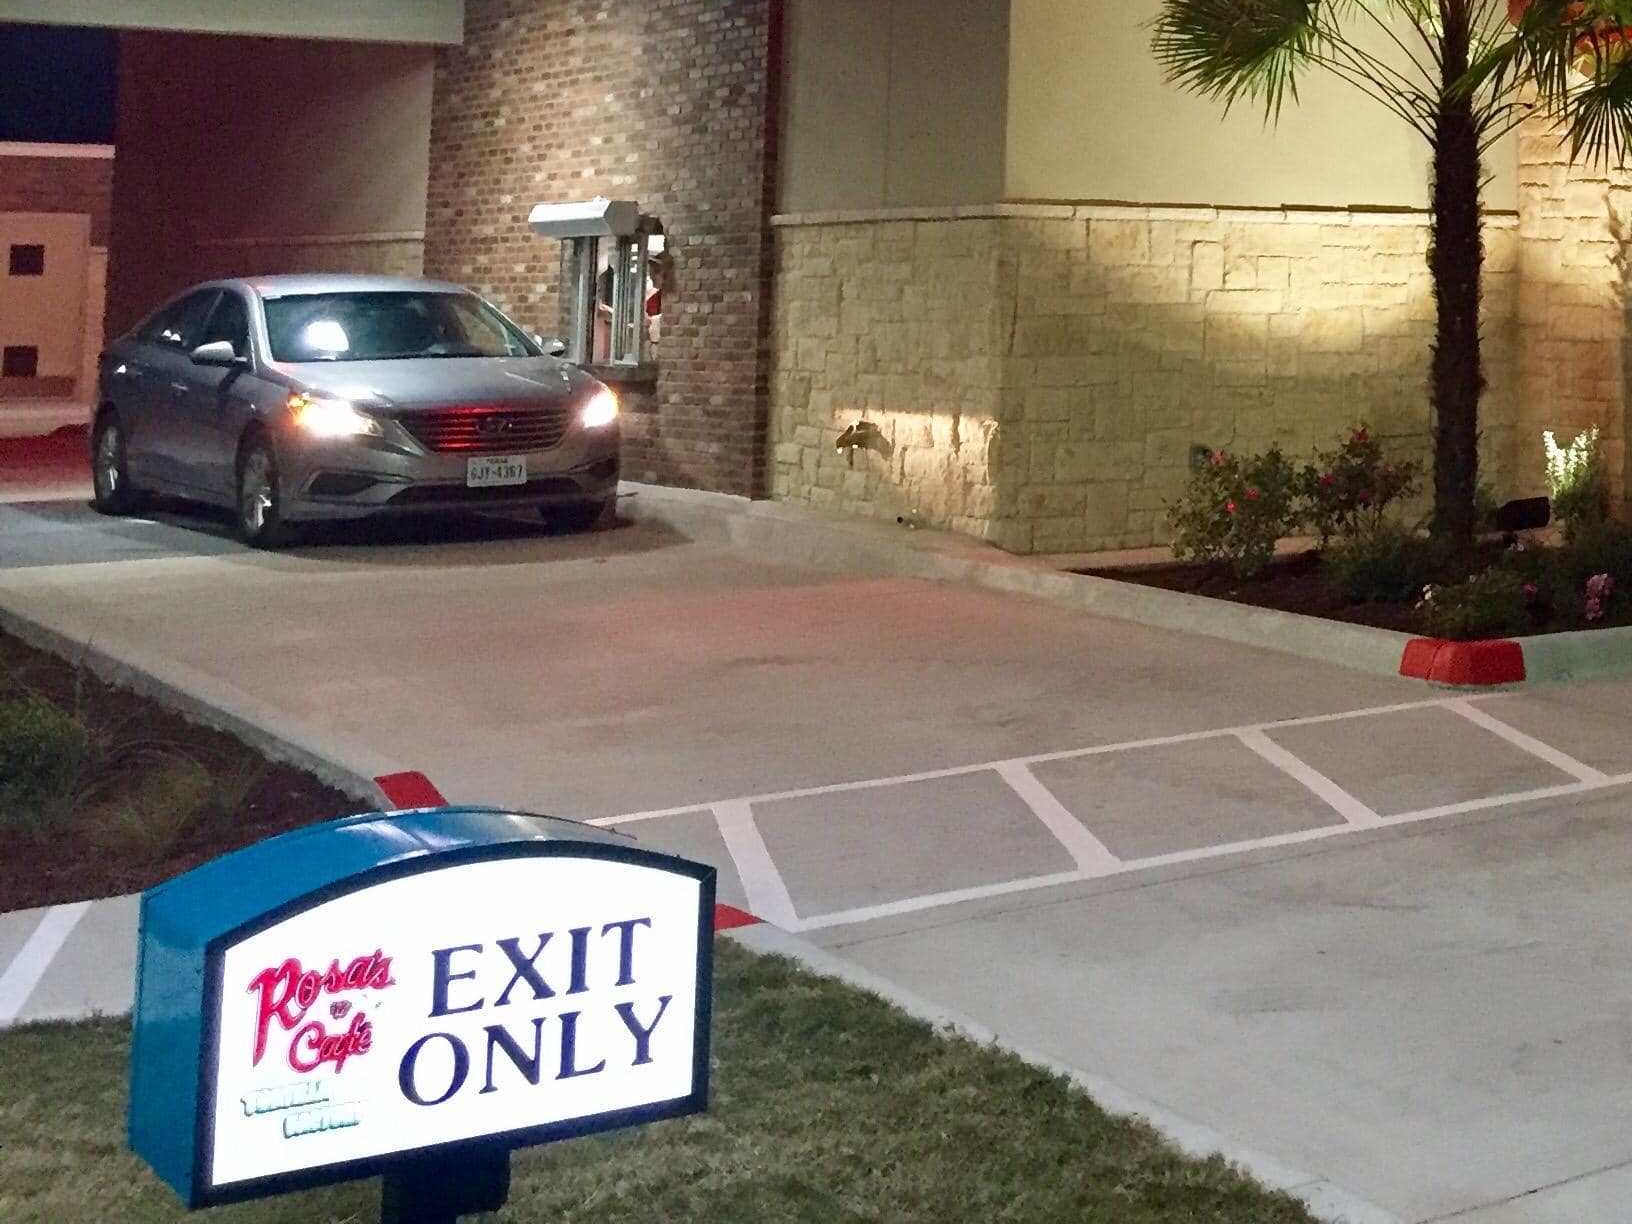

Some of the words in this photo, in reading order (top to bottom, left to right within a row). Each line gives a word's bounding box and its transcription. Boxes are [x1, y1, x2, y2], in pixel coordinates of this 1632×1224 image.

[246, 948, 396, 1068] Rosa's
[427, 917, 652, 1018] EXIT
[398, 994, 673, 1106] ONLY
